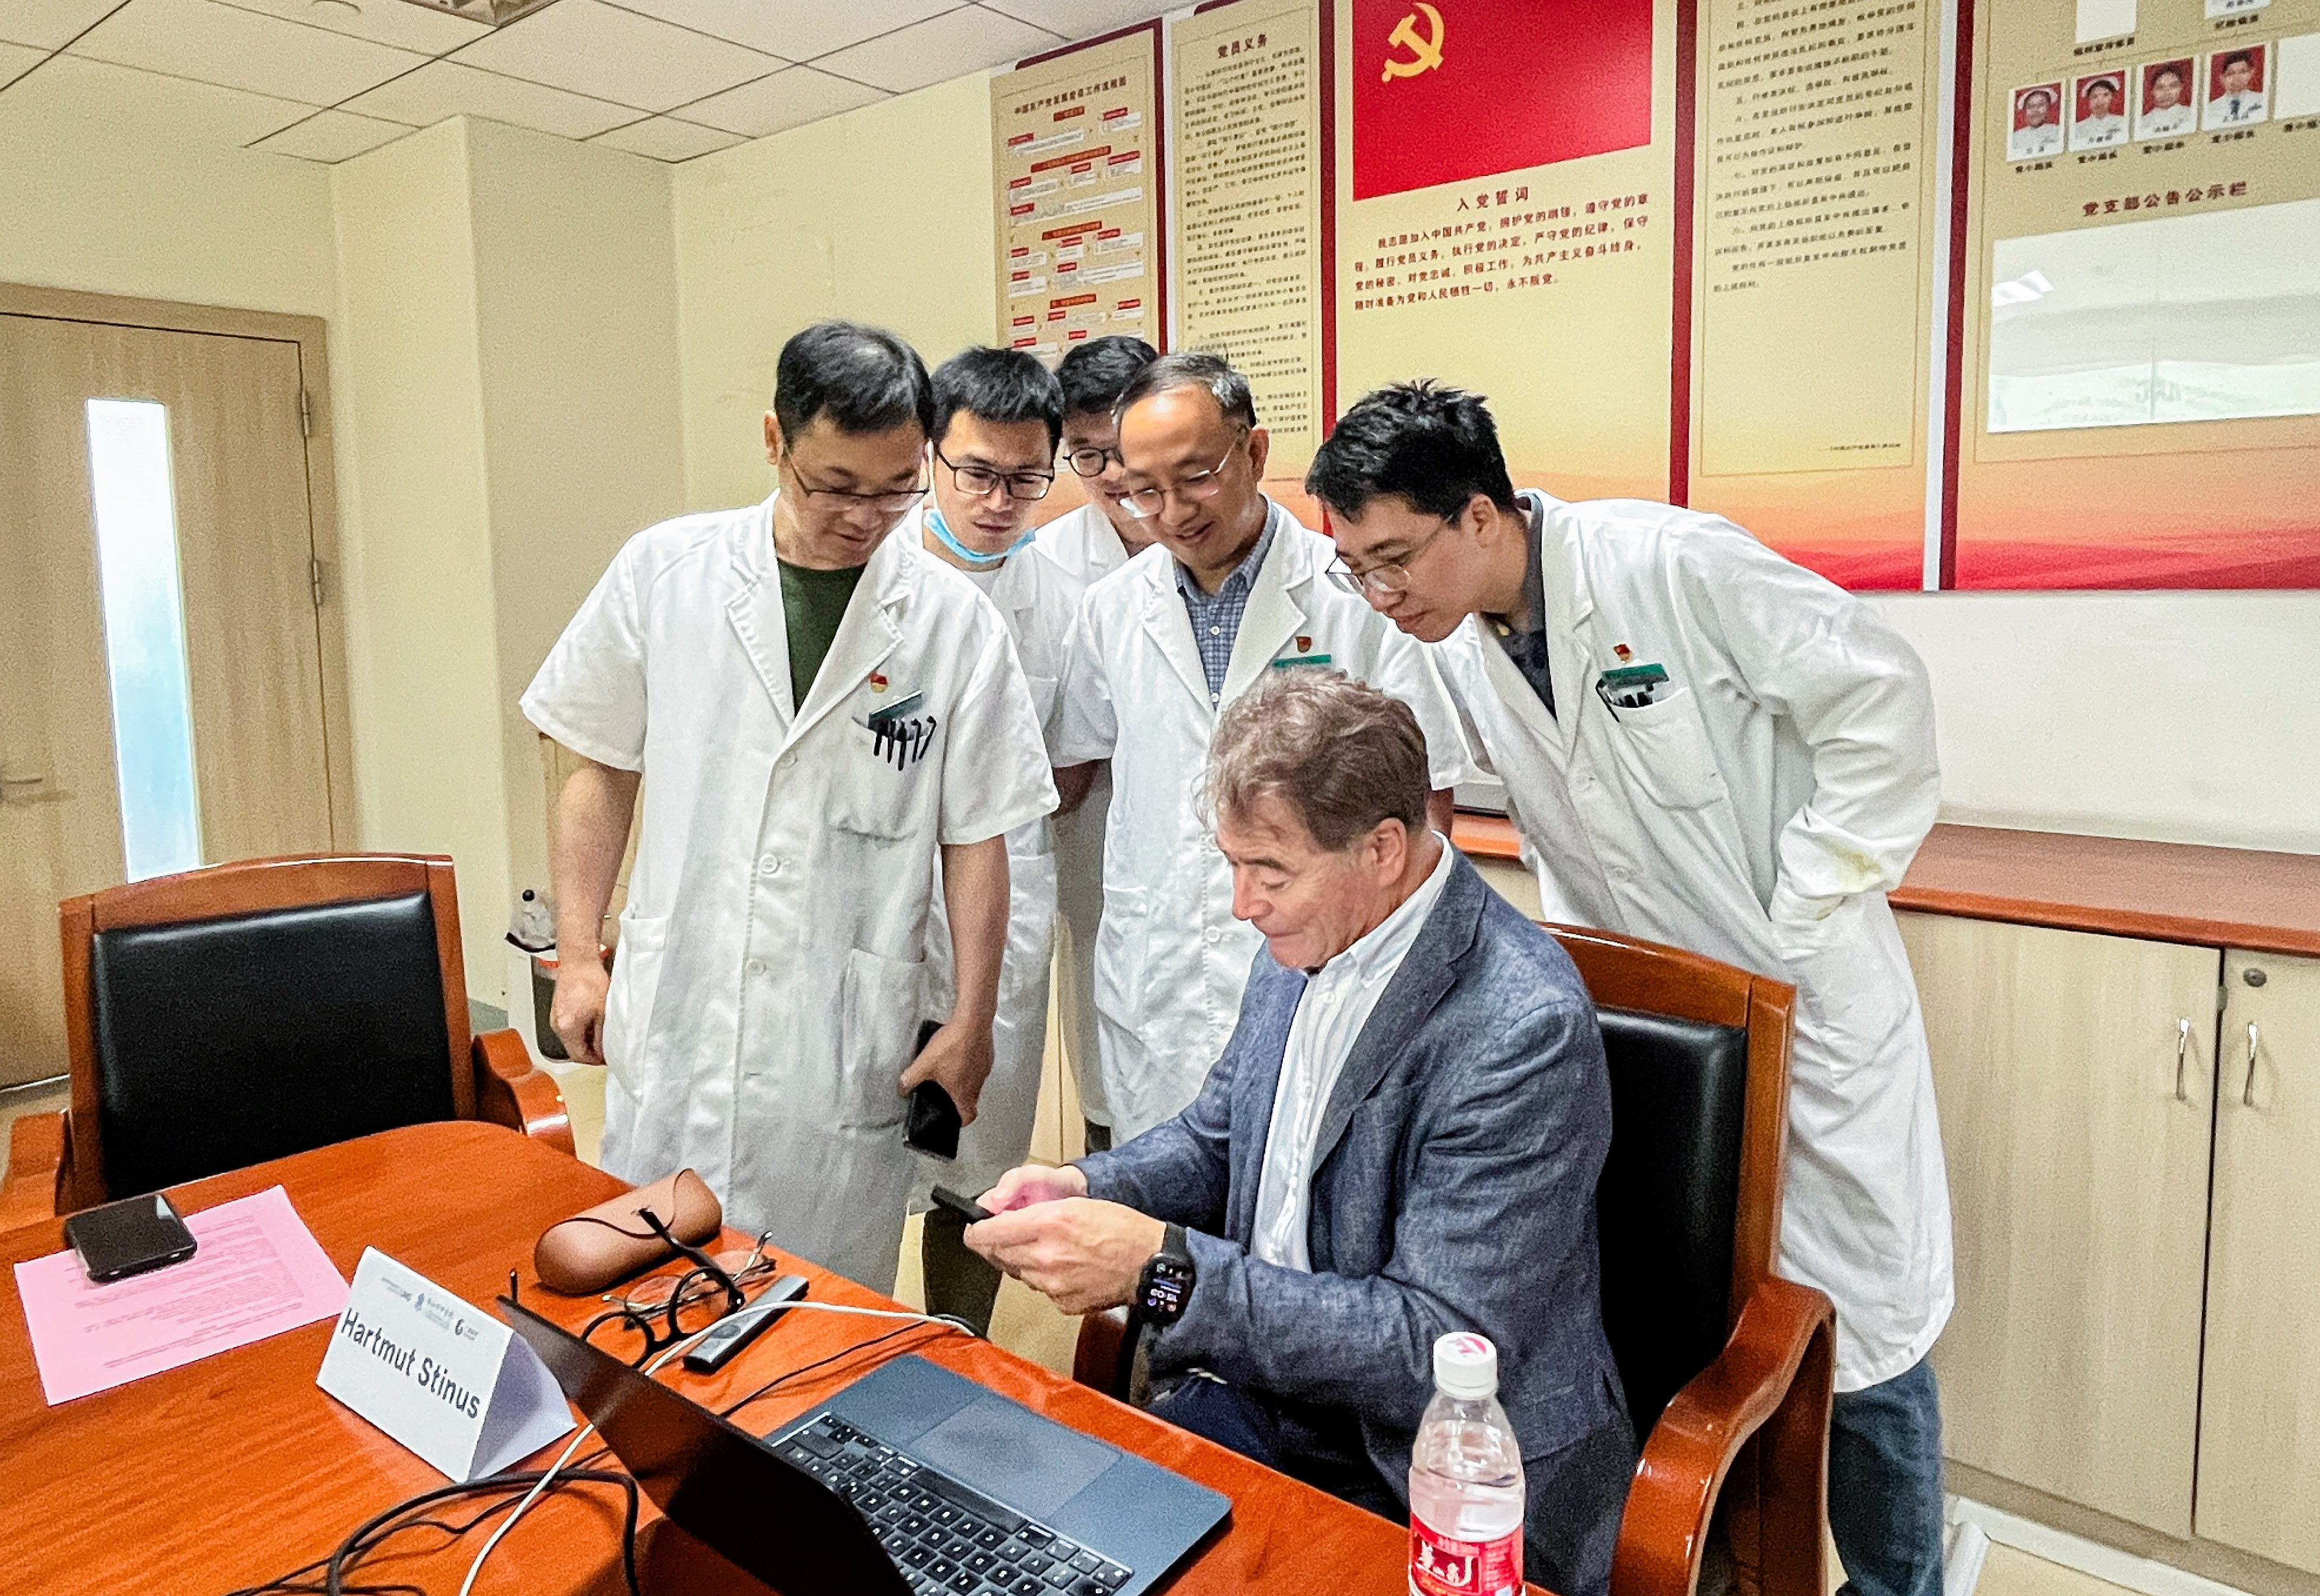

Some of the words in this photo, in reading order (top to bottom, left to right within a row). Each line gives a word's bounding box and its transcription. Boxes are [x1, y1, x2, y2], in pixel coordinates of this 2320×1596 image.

[1218, 33, 1268, 59] 党员义务
[1456, 186, 1528, 211] 入党誓词
[2083, 181, 2247, 216] 党支部公告公示栏
[341, 1307, 416, 1377] Hartmut
[418, 1357, 481, 1418] Stinus
